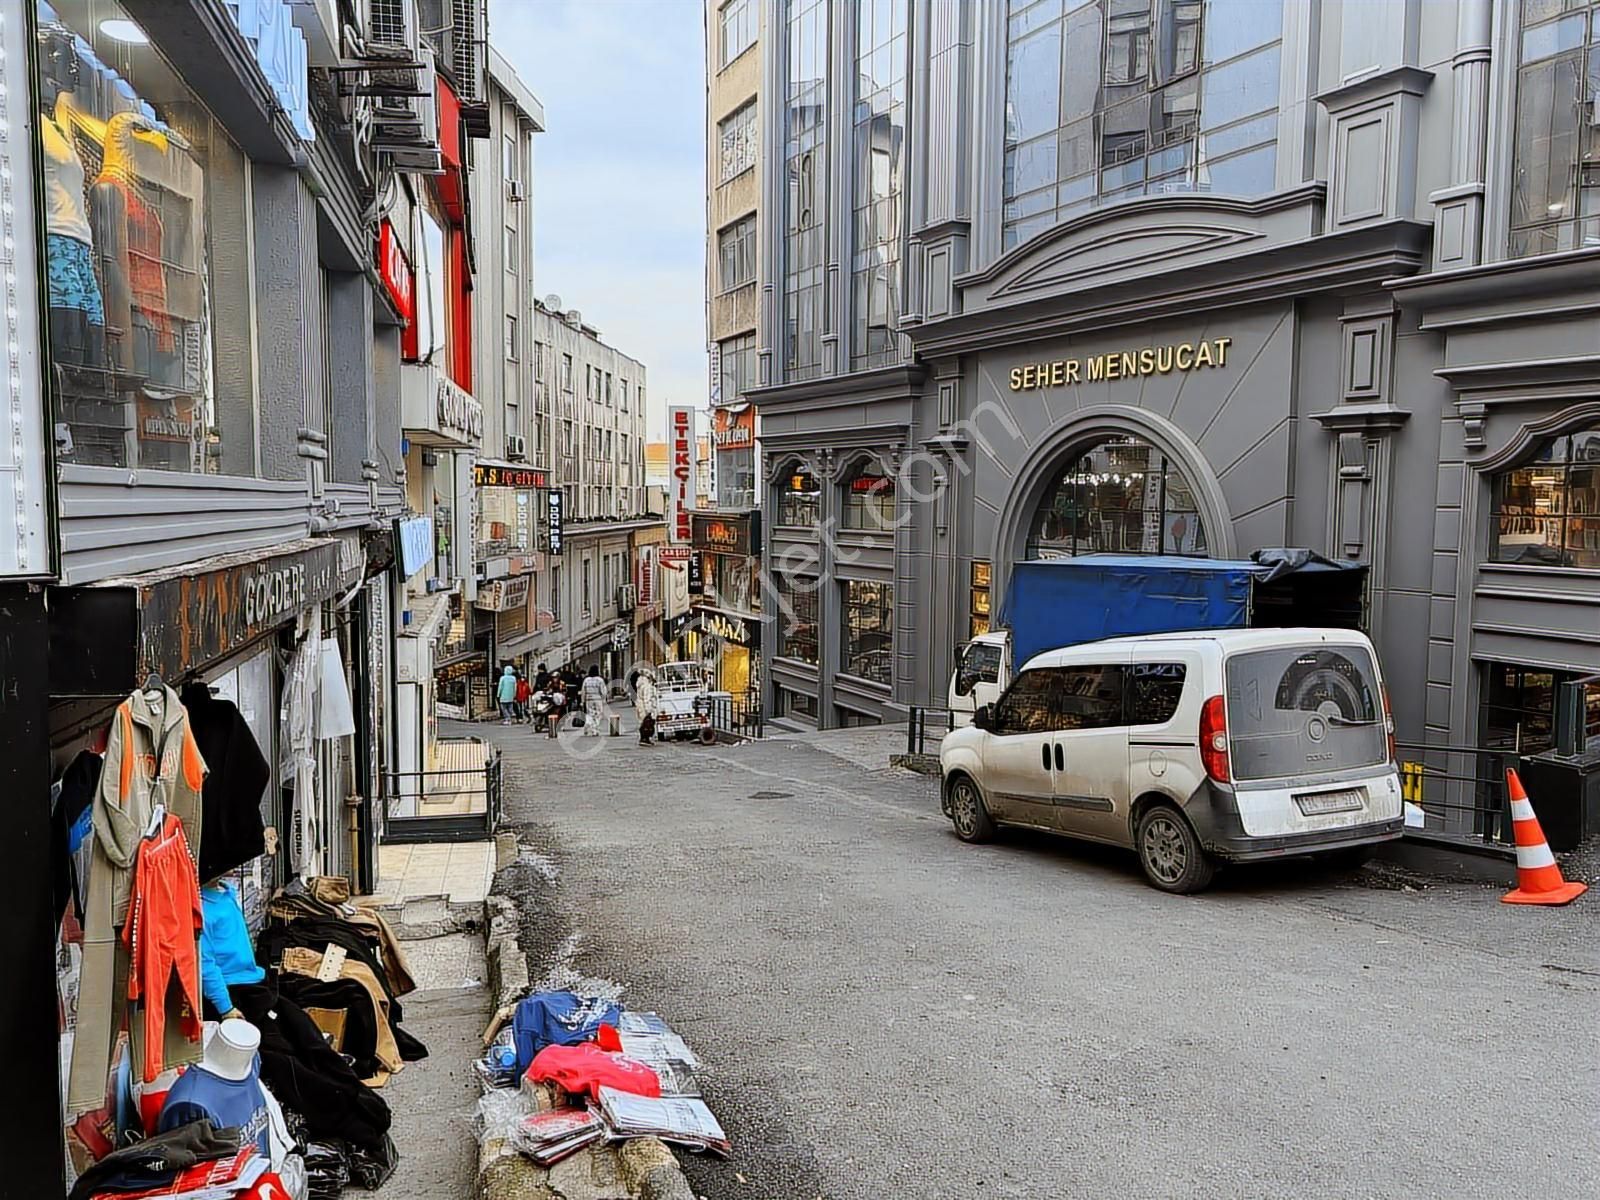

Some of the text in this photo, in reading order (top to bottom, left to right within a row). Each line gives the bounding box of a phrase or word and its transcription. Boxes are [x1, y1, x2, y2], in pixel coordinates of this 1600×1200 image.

[1009, 337, 1233, 392] SEHER MENSUCAT
[674, 411, 692, 540] ETEKÇİLER
